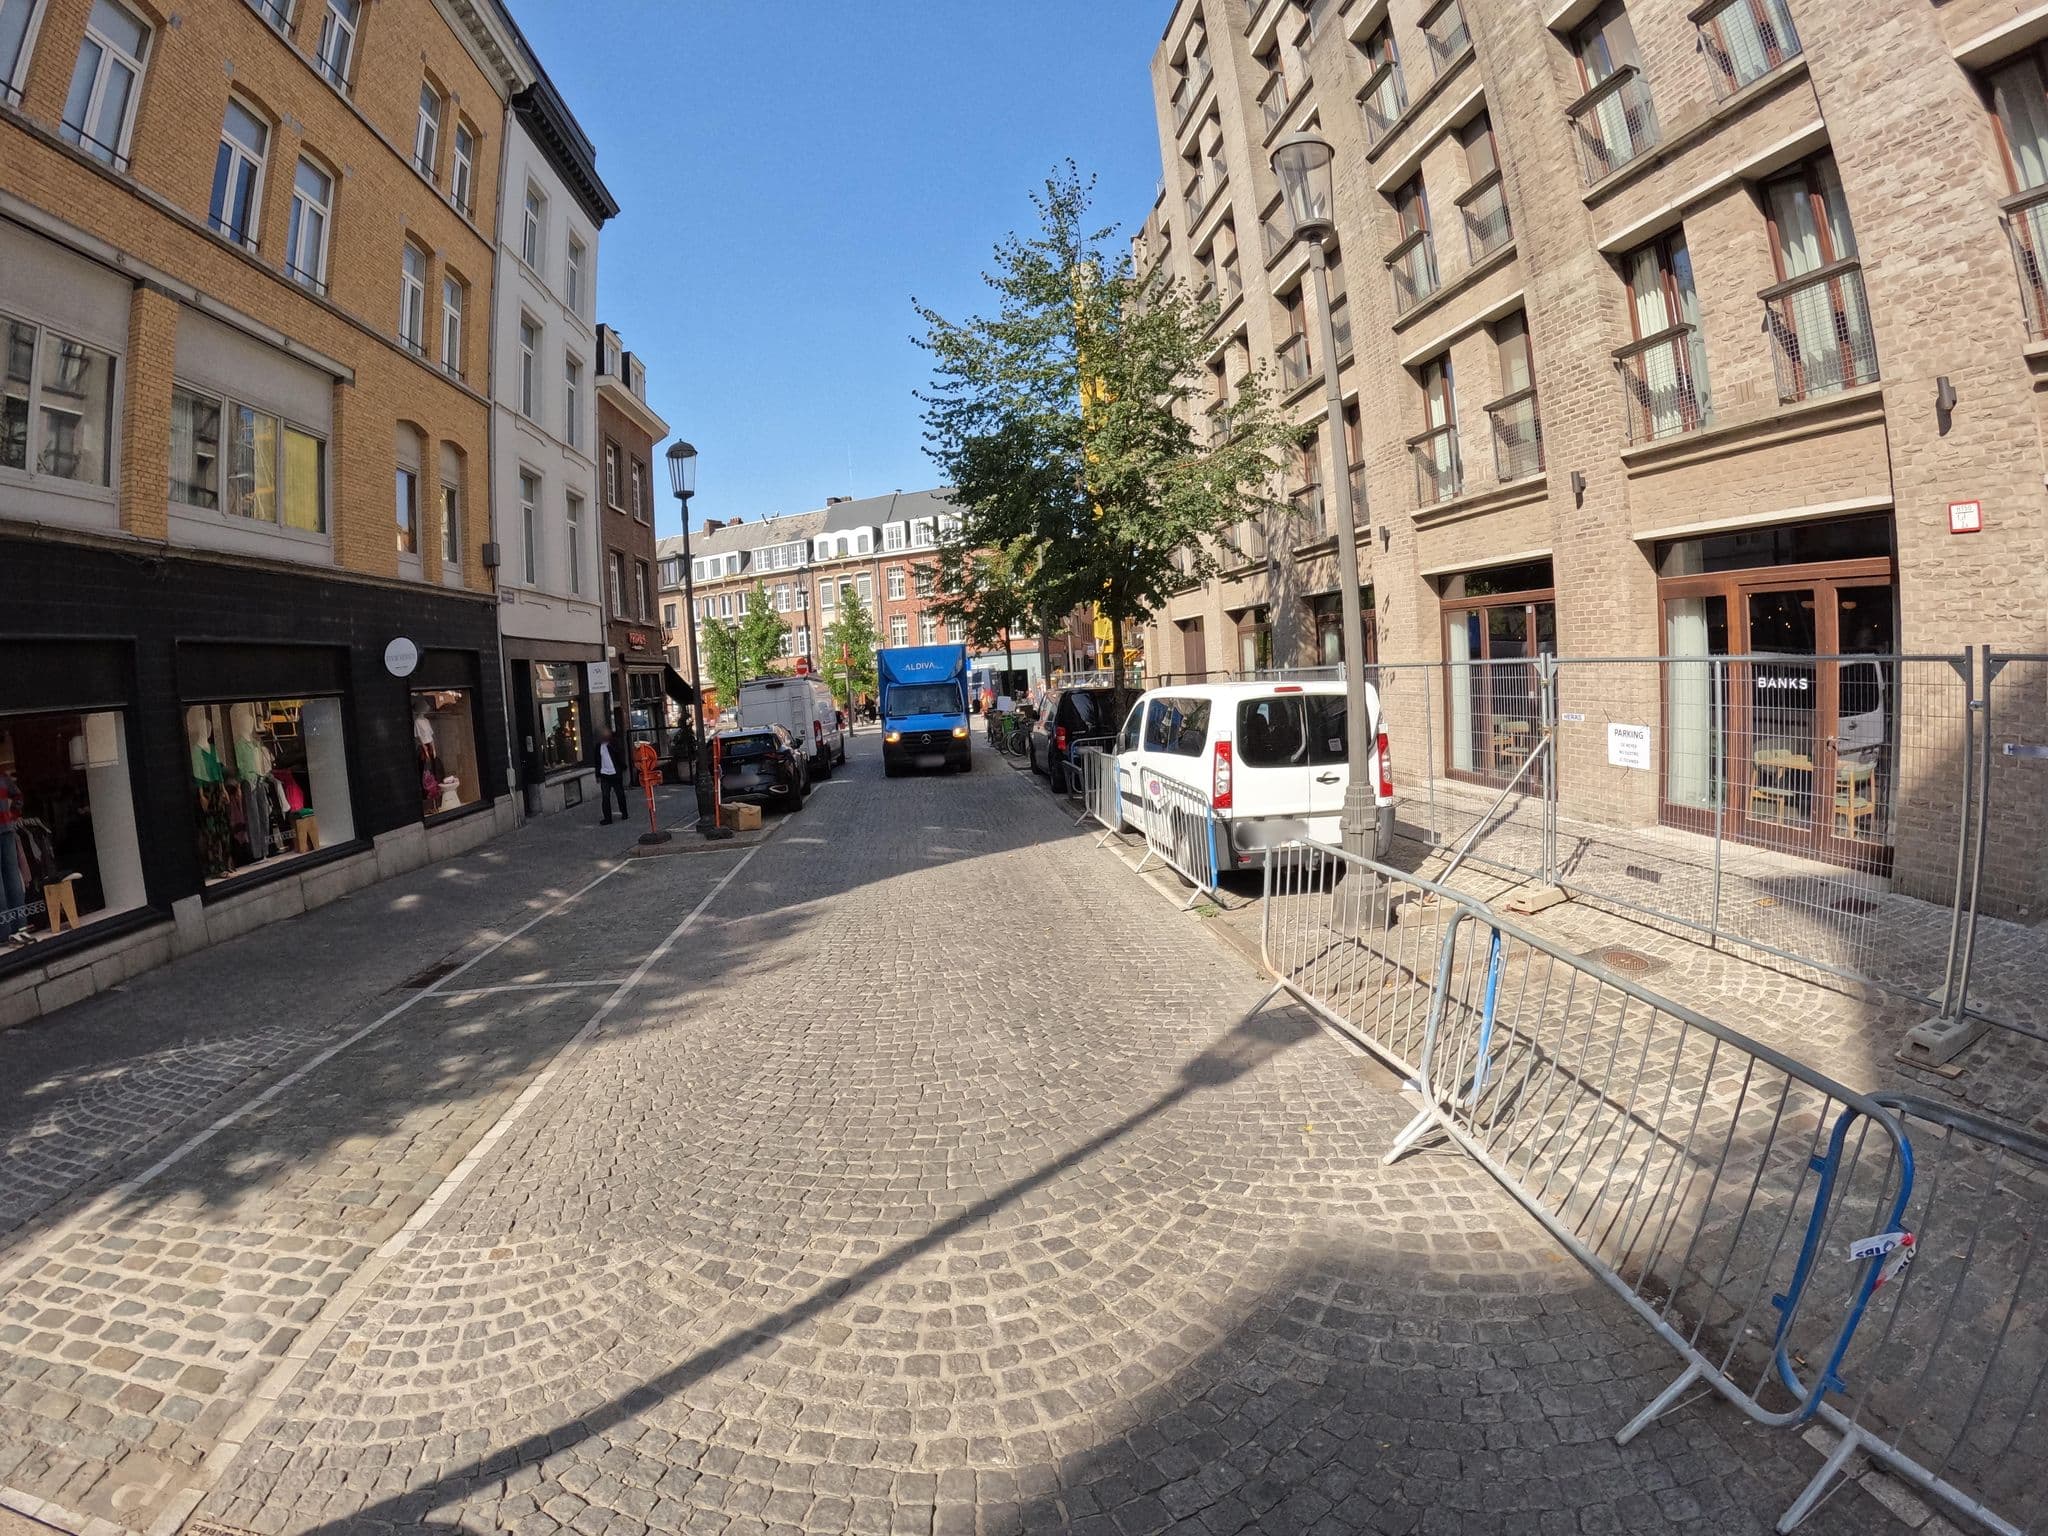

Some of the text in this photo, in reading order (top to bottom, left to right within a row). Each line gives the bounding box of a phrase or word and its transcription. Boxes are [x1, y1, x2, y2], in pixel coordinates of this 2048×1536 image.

[905, 662, 935, 671] ALDIVA
[1758, 676, 1808, 690] BANKS
[1614, 728, 1644, 740] PARKING
[17, 902, 46, 920] ROSES
